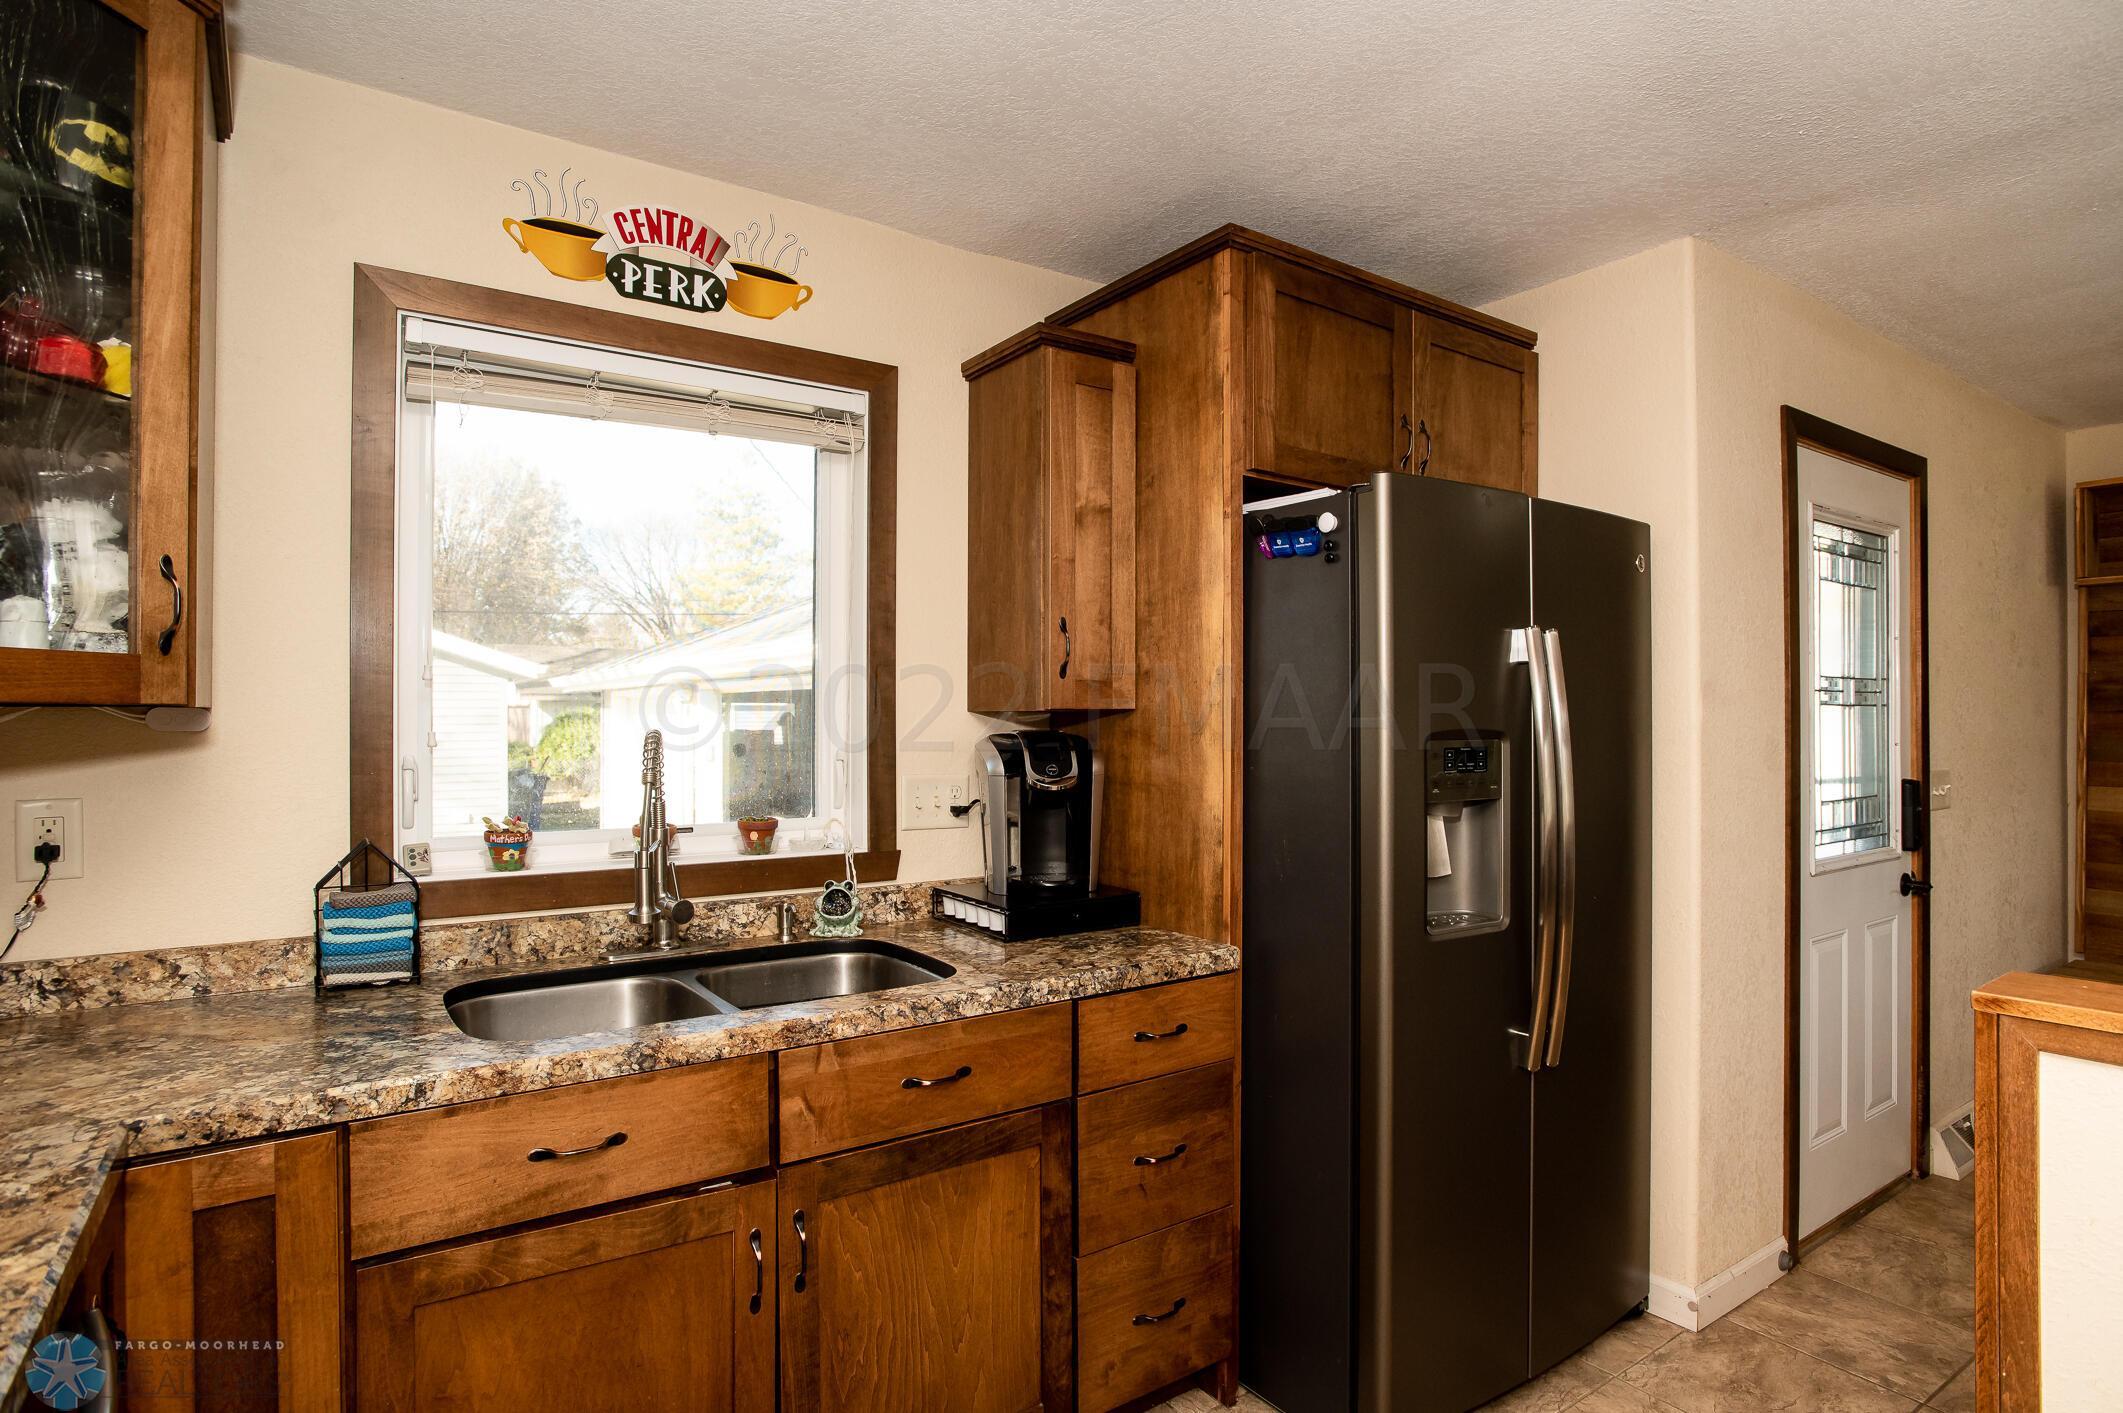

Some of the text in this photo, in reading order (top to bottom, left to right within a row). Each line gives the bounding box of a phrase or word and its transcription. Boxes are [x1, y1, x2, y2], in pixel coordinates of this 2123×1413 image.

[613, 207, 722, 267] CENTRAL
[620, 258, 715, 309] PERK
[490, 833, 523, 843] Mother's
